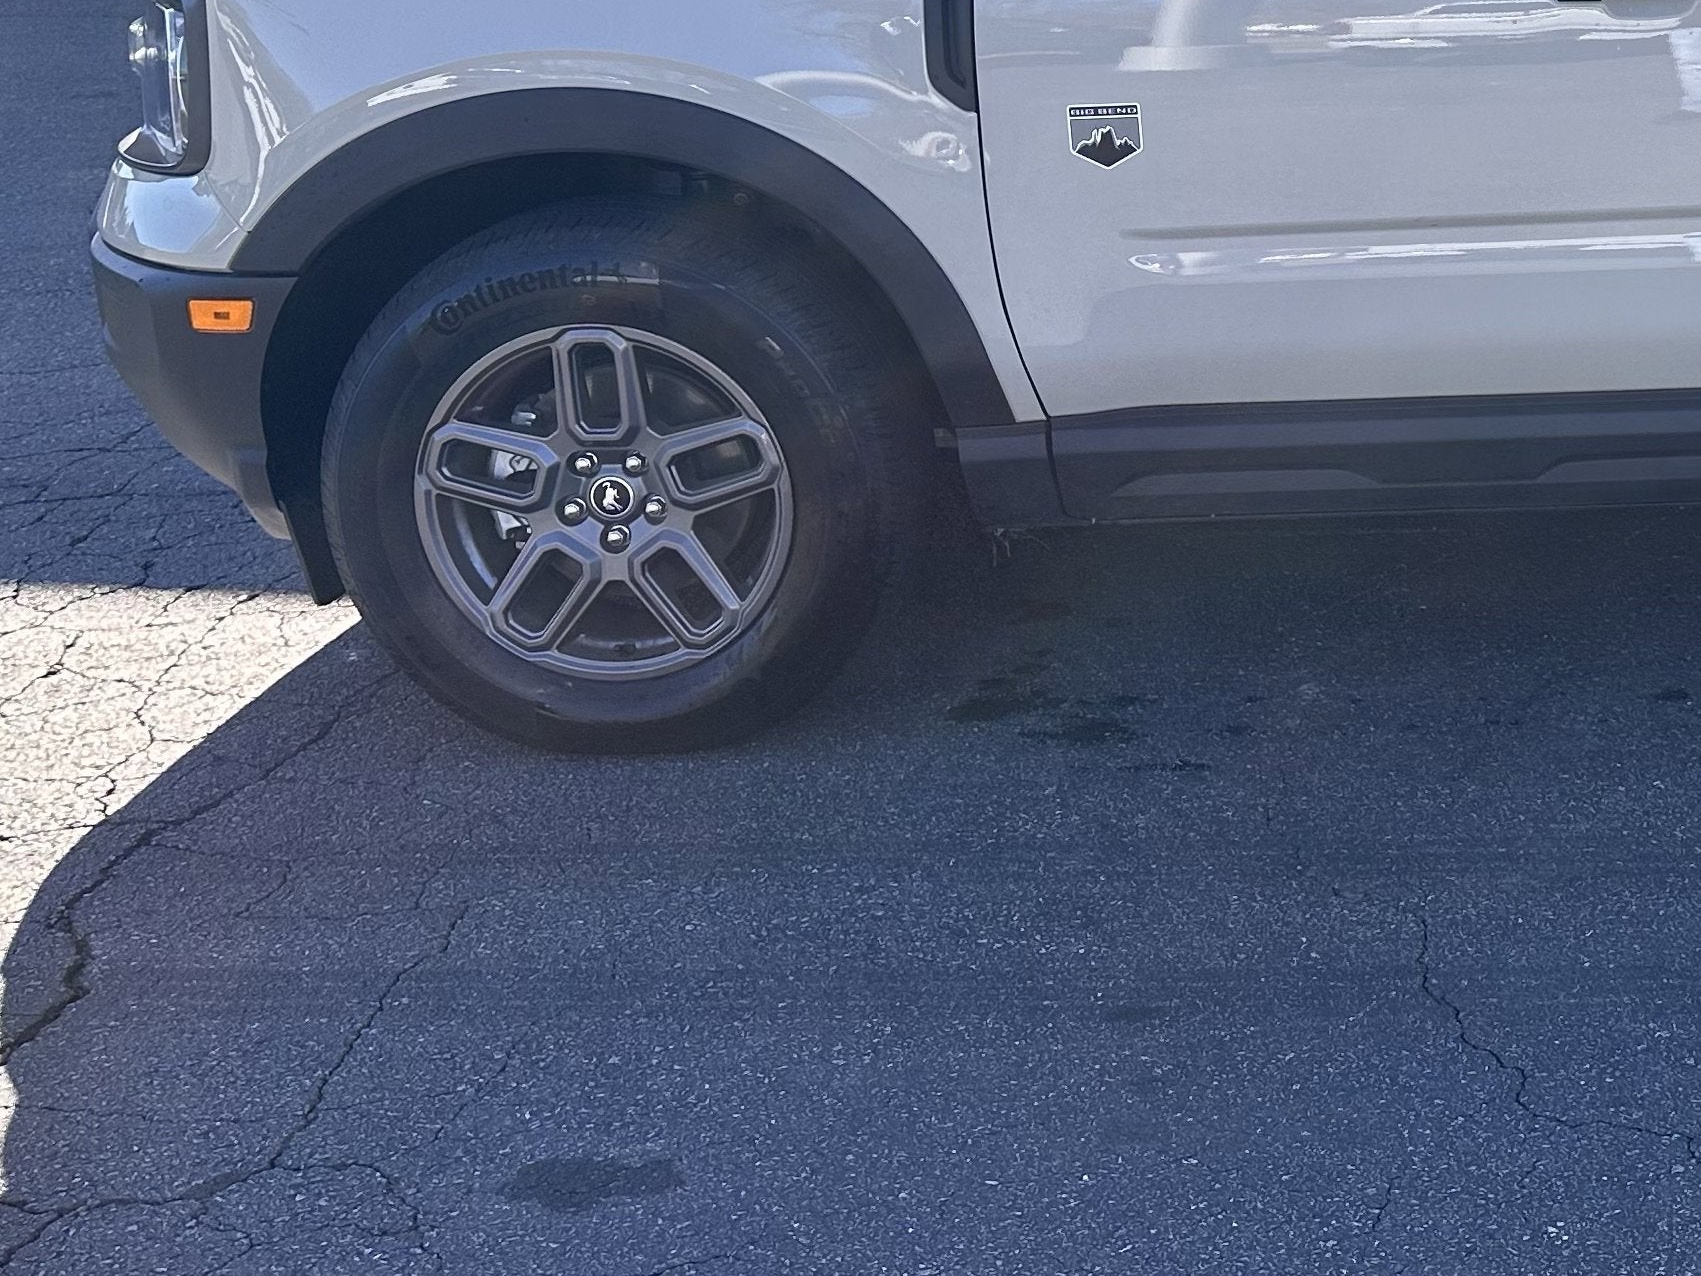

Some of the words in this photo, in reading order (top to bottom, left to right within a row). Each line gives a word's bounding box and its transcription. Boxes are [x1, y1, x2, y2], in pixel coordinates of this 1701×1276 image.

[1070, 108, 1094, 116] BIG
[1098, 107, 1136, 115] BEND
[431, 260, 598, 335] Continental
